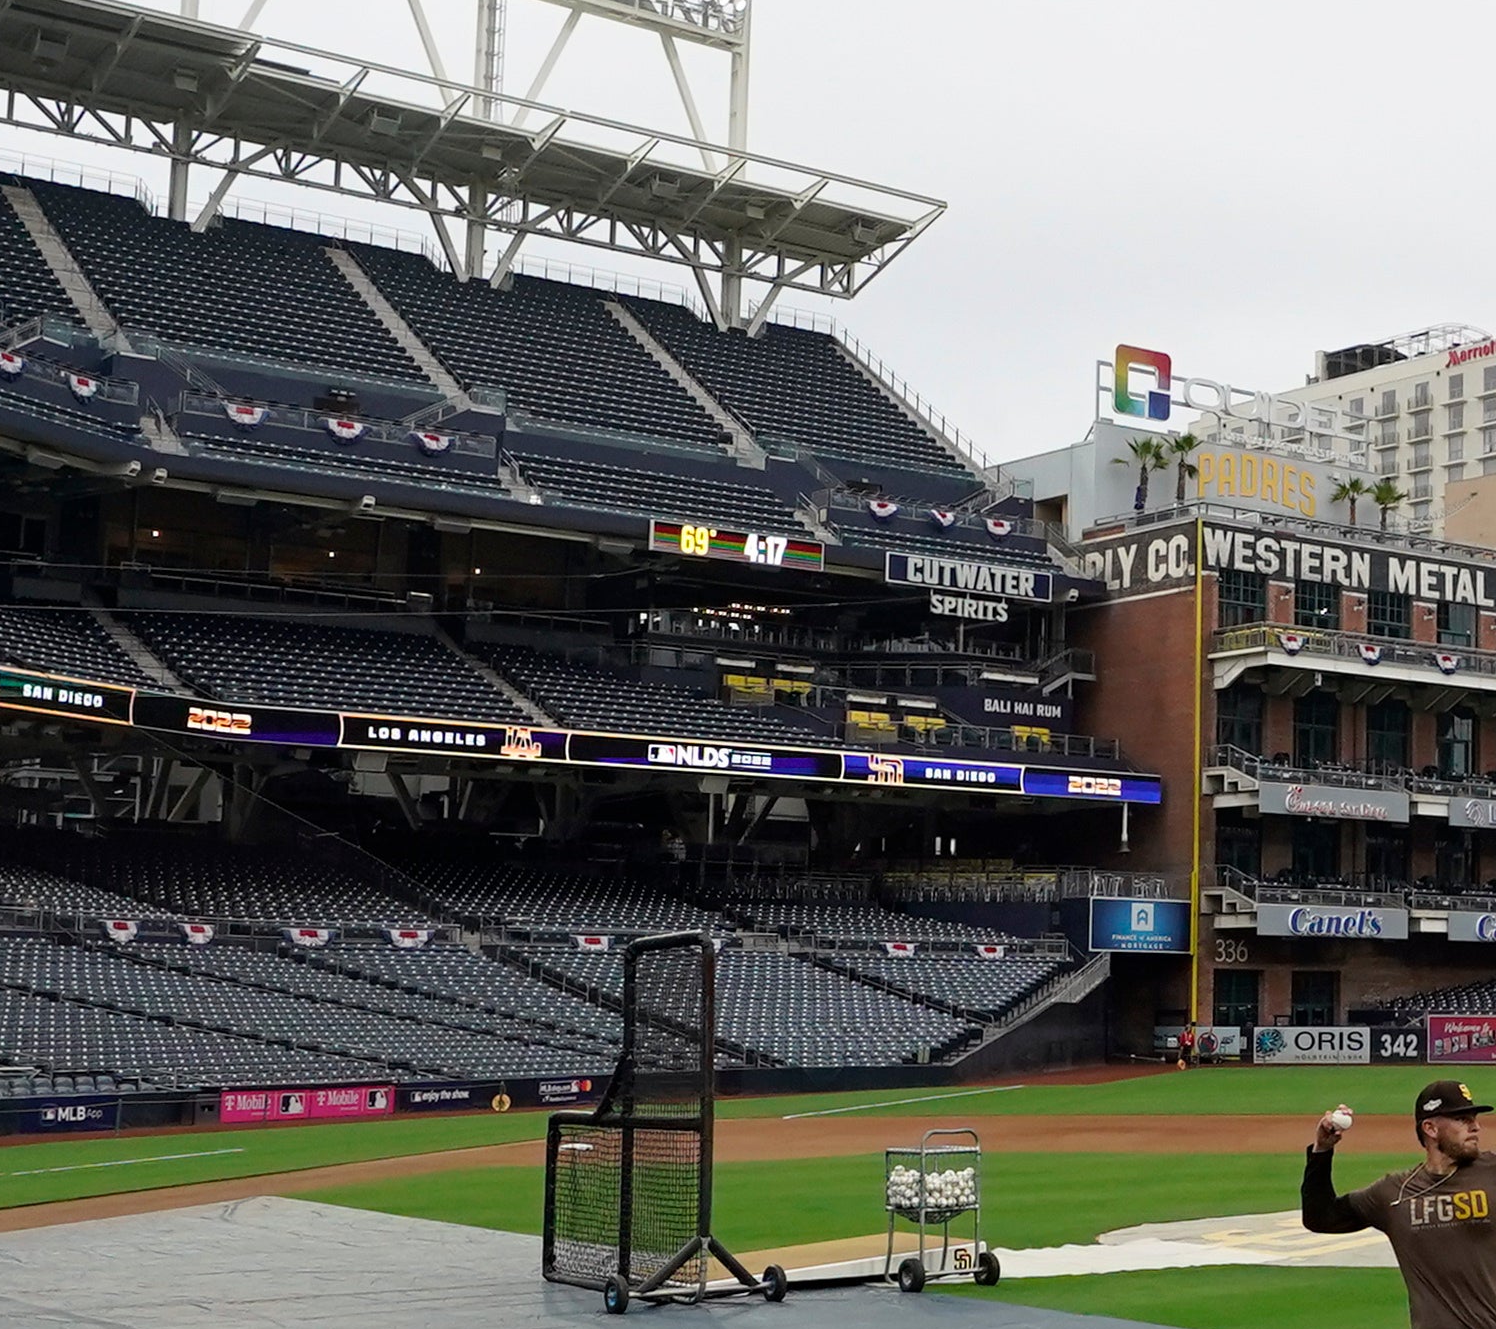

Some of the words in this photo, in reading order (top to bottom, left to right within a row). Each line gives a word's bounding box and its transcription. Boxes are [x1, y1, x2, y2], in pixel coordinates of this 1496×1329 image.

[1198, 452, 1316, 519] PADRES
[744, 534, 788, 566] 4:17
[1148, 534, 1195, 583] CO.
[907, 555, 1035, 598] CUTWATER
[1203, 526, 1371, 589] WESTERN
[1387, 558, 1495, 609] METAL
[930, 593, 1009, 623] SPIRITS
[22, 682, 53, 702] SAN
[58, 688, 104, 708] DIEGO
[984, 698, 1010, 714] BALI
[1014, 699, 1033, 716] HAI
[1036, 703, 1062, 719] RUM
[187, 707, 252, 735] 2022
[367, 726, 402, 743] LOS
[407, 728, 486, 747] ANGELES
[676, 745, 730, 769] NLDS
[732, 752, 772, 766] 2022
[925, 767, 948, 780] SAN
[953, 770, 996, 784] DIEGO
[1068, 775, 1122, 796] 2022
[1288, 907, 1382, 938] Canel's
[1111, 934, 1137, 942] FINANCE
[1146, 935, 1172, 943] AMERICA
[1121, 942, 1164, 950] MORTGAGE
[1215, 938, 1248, 963] 336
[1294, 1031, 1364, 1051] ORIS
[1380, 1034, 1418, 1058] 342
[327, 1089, 359, 1106] Mobile
[57, 1105, 86, 1121] MLB
[1409, 1189, 1489, 1226] LFGSD
